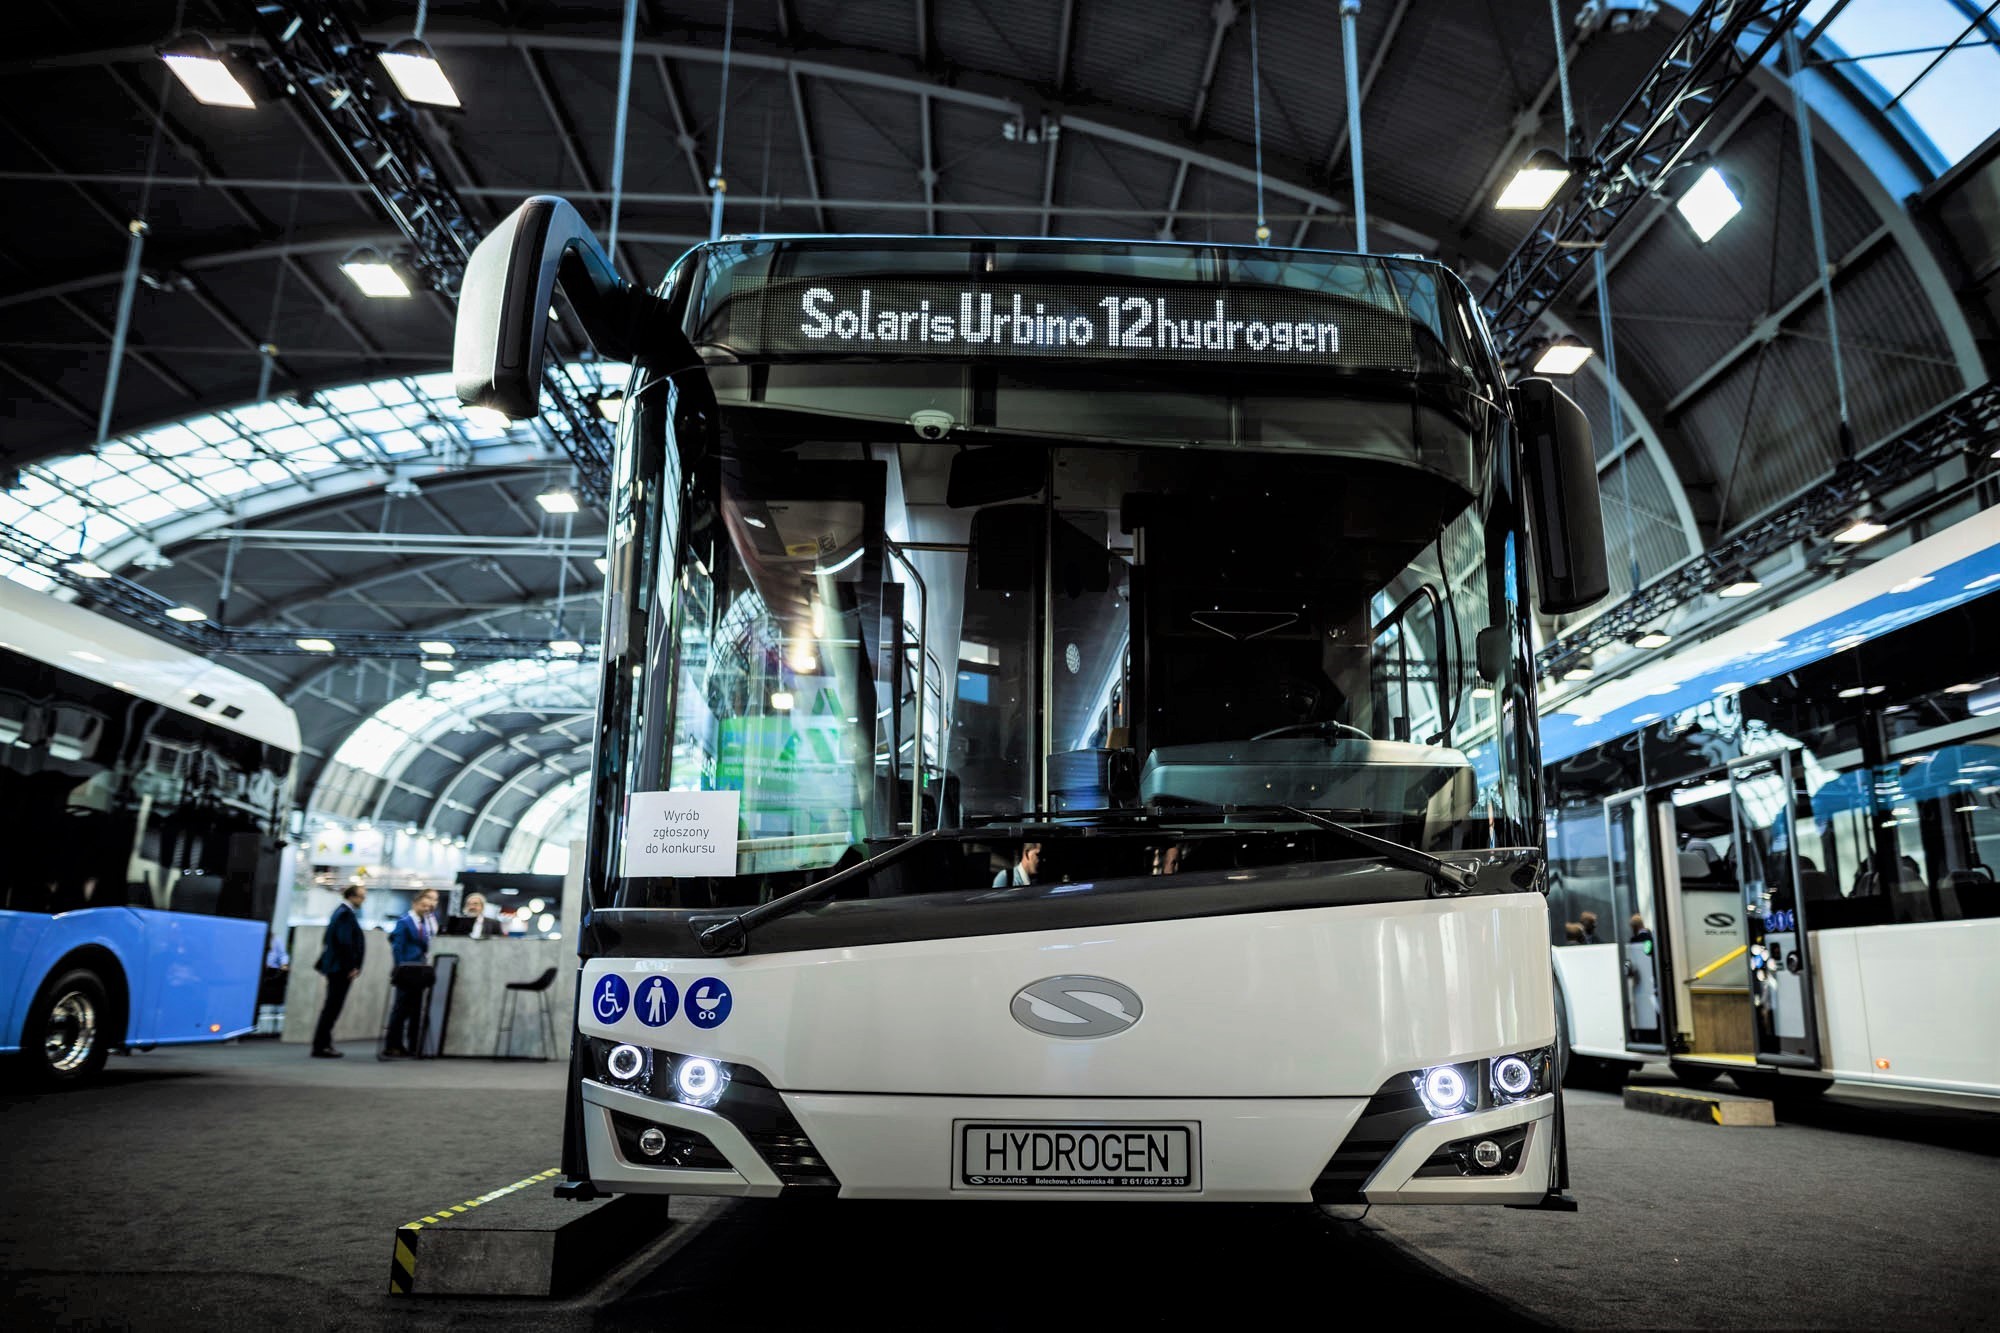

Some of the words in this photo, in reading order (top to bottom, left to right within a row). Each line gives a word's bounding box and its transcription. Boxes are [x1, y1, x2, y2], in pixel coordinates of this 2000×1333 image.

[960, 292, 1093, 346] Urbino
[1157, 298, 1339, 353] hydrogen
[664, 808, 700, 823] Wyrób
[653, 827, 710, 839] zgłoszony
[645, 843, 658, 854] do
[662, 843, 716, 854] konkursu
[985, 1132, 1169, 1172] HYDROGEN
